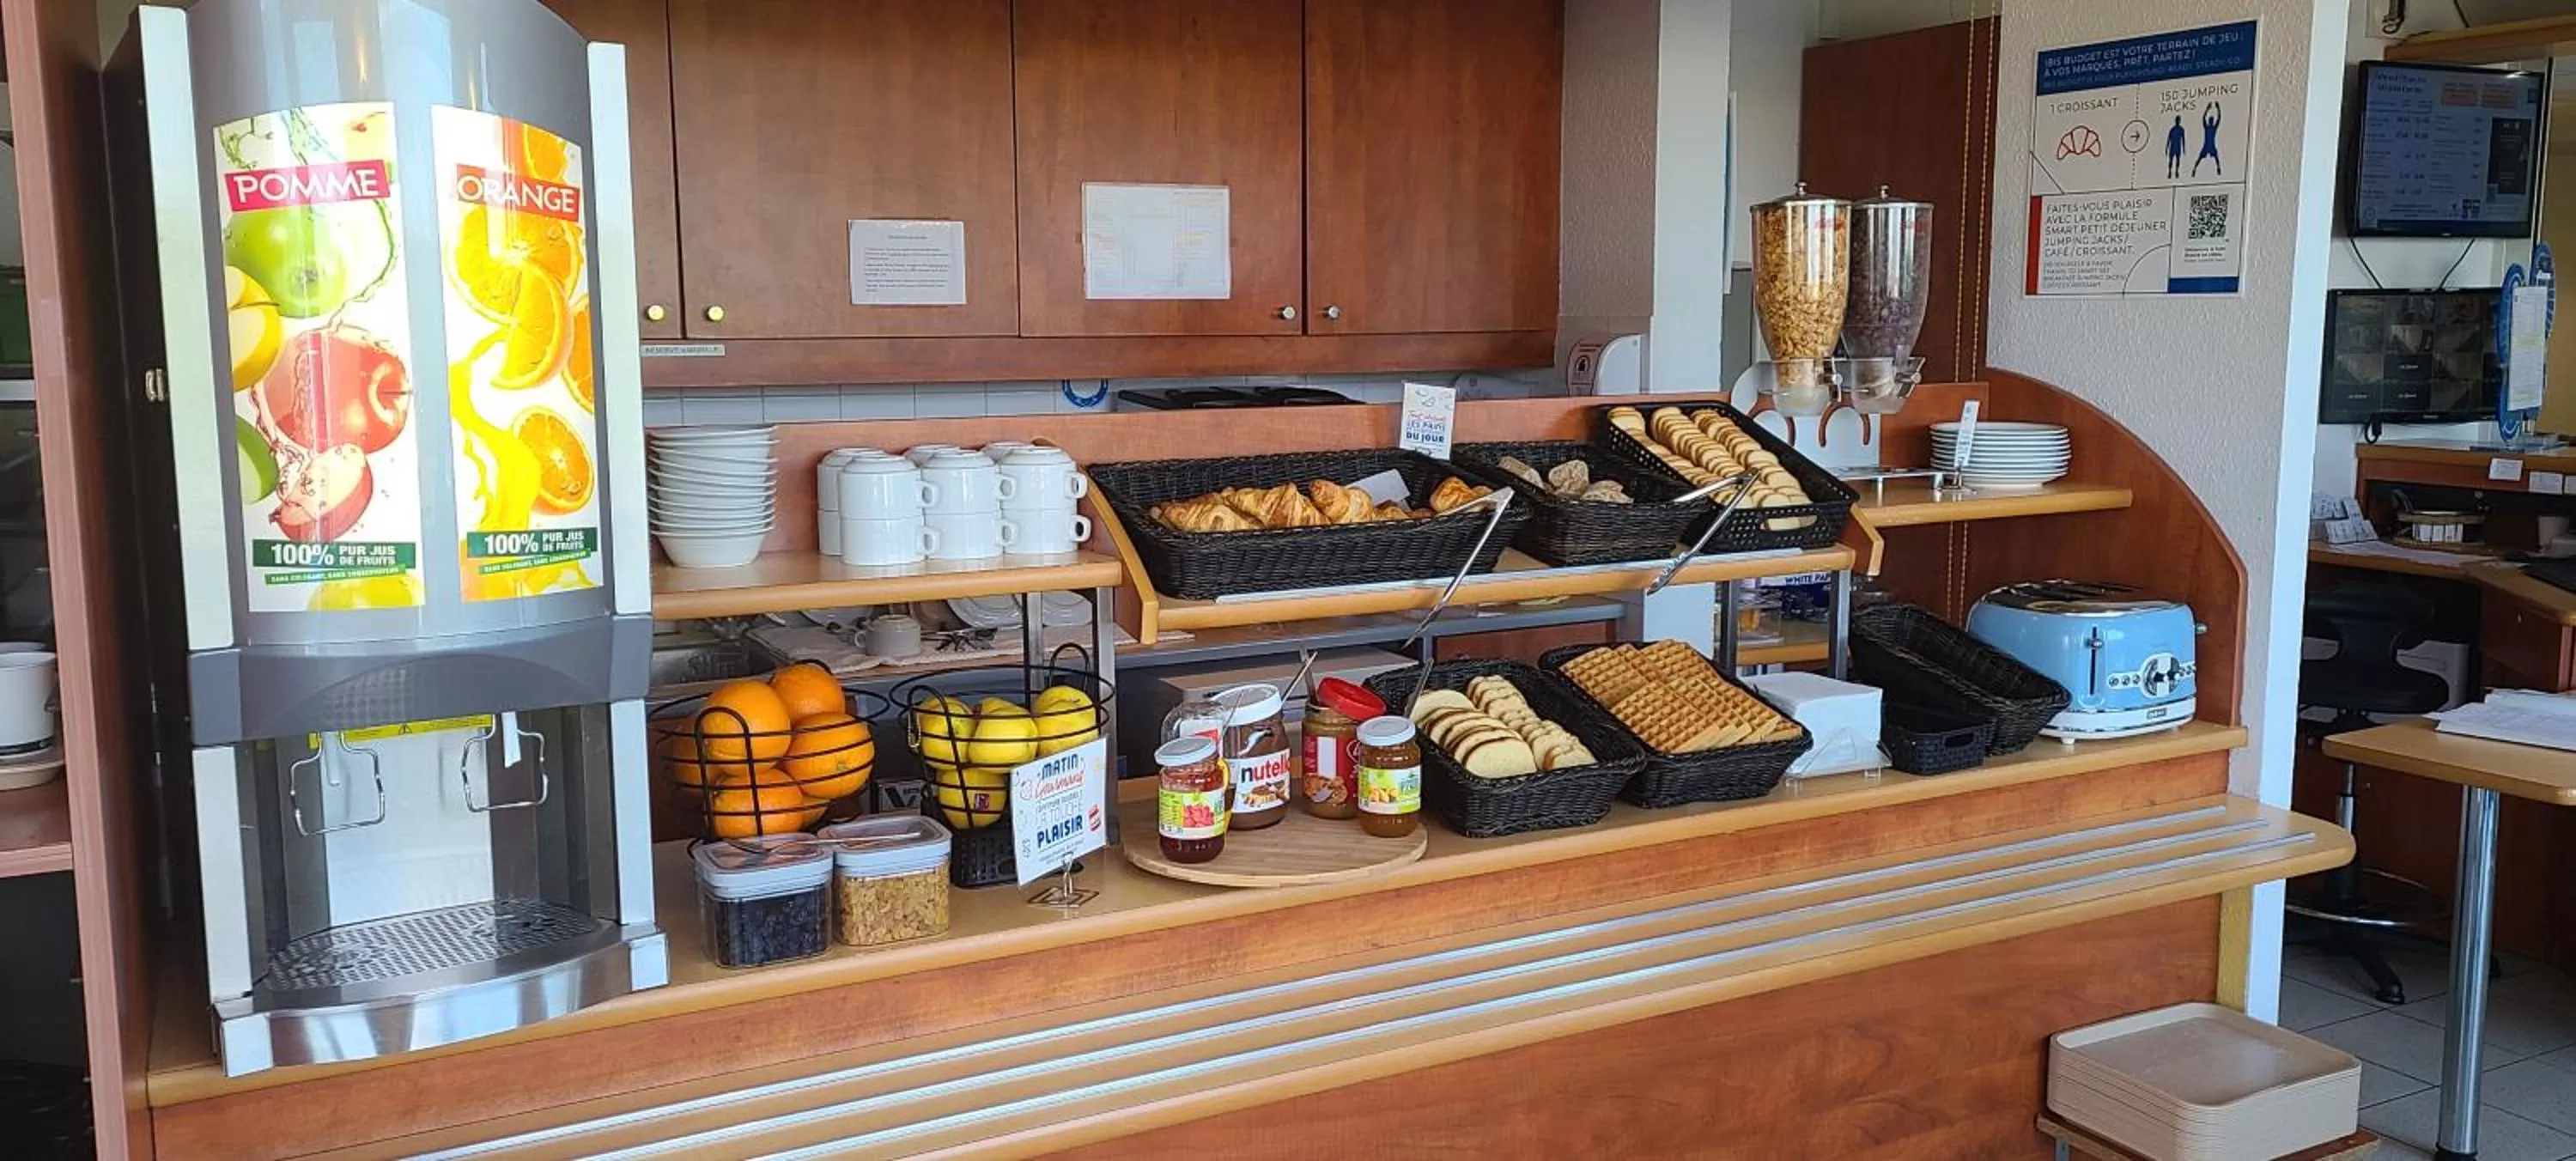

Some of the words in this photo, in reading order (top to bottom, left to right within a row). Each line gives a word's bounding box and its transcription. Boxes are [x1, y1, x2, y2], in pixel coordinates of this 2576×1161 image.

[2063, 50, 2103, 65] BUDGET
[2104, 48, 2120, 59] EST
[2122, 45, 2154, 57] VOTRE
[2156, 39, 2200, 53] TERRAIN
[2202, 35, 2216, 46] DE
[2218, 33, 2239, 44] JEU
[2051, 65, 2071, 76] VOS
[2182, 83, 2239, 100] JUMPING
[2057, 97, 2119, 113] CROISSANT
[2160, 100, 2197, 113] JACKS
[234, 168, 379, 204] POMME
[456, 174, 577, 215] ORANGE
[2045, 214, 2070, 225] AVEC
[2074, 213, 2087, 224] LA
[2044, 224, 2080, 236] SMART
[1406, 431, 1419, 440] DU
[1421, 433, 1444, 443] JOUR
[483, 533, 539, 555] 100%
[542, 532, 563, 543] PUR
[565, 530, 584, 541] JUS
[542, 542, 554, 551] DE
[556, 540, 584, 550] FRUITS
[270, 543, 334, 566] 100%
[339, 544, 367, 556] PUR
[370, 544, 396, 556] JUS
[339, 556, 355, 566] DE
[356, 556, 396, 566] FRUITS
[1042, 753, 1078, 780] MATIN
[1036, 814, 1083, 849] PLAISIR
